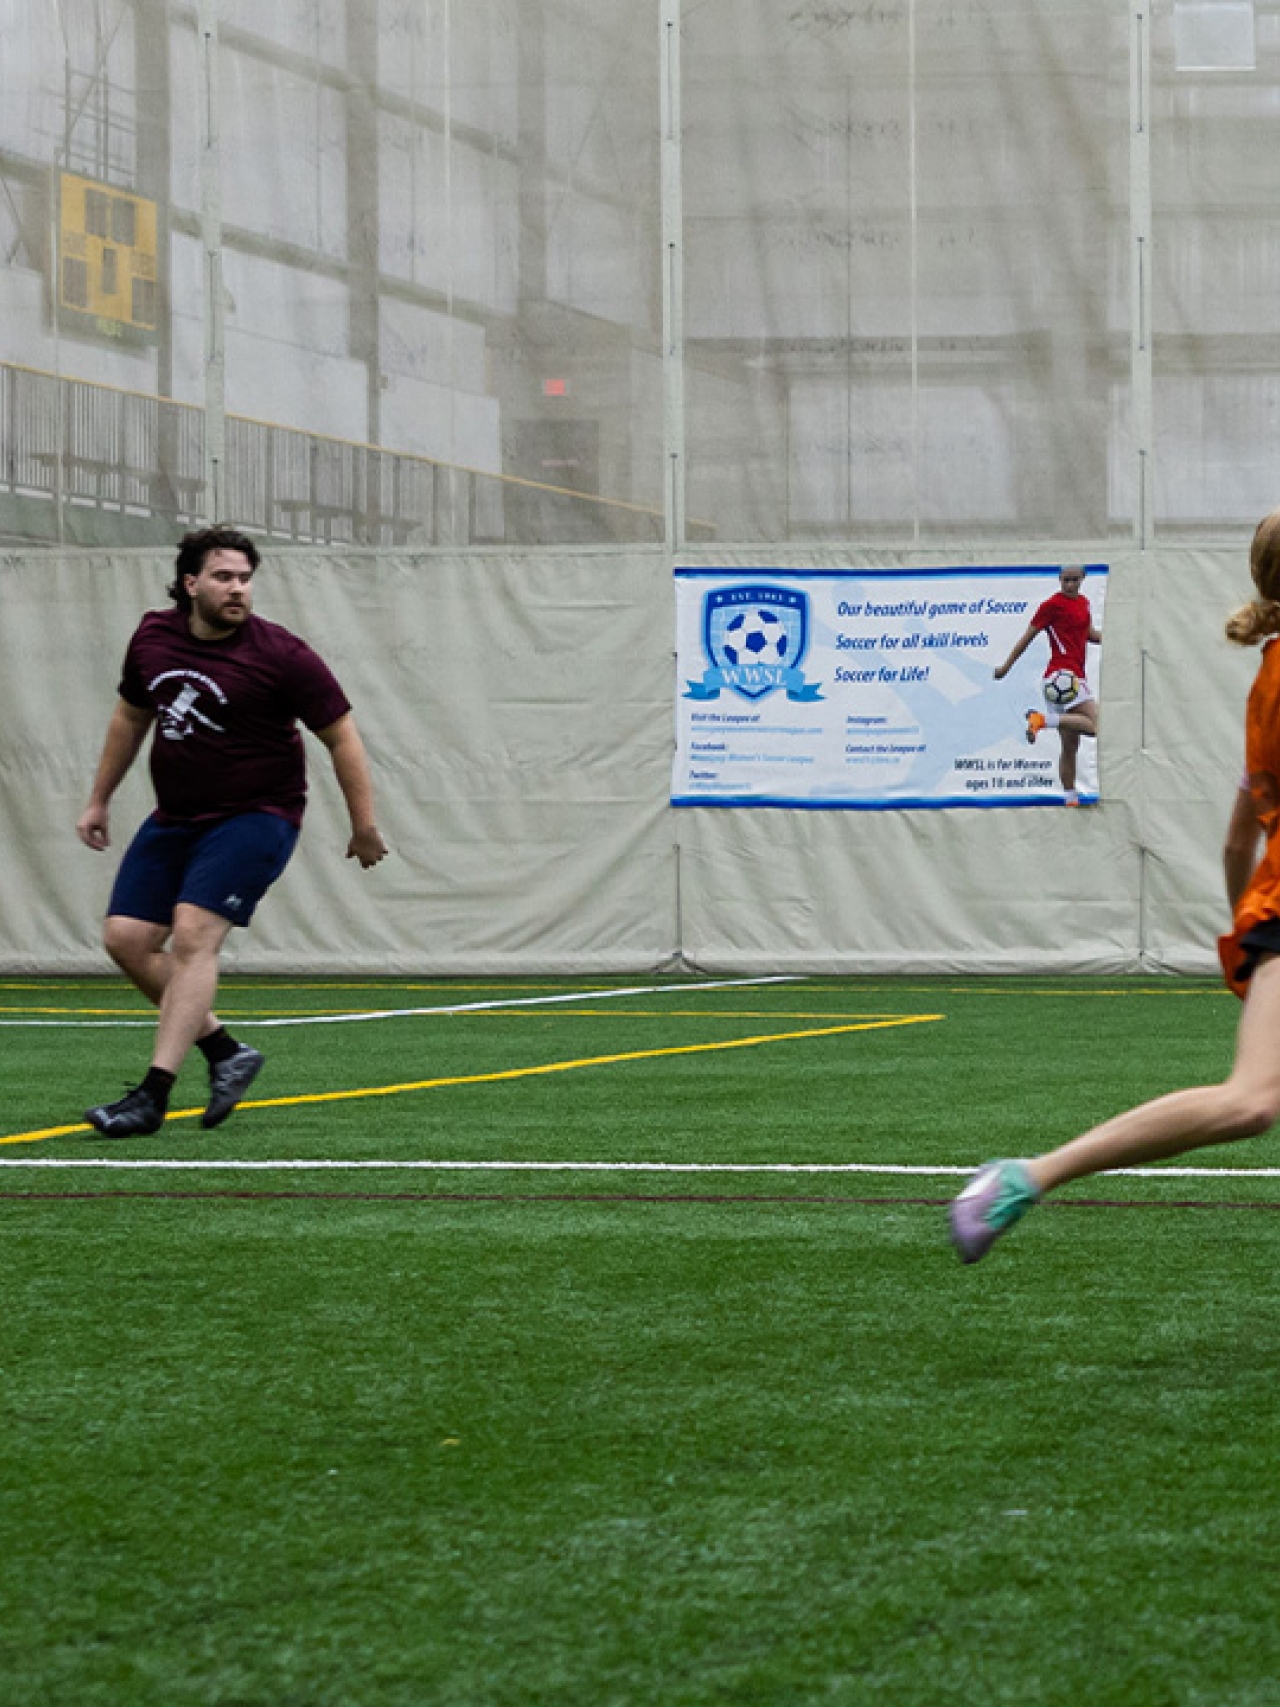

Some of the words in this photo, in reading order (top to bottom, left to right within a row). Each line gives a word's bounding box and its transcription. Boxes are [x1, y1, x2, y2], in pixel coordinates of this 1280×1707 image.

[838, 601, 863, 617] Our
[864, 601, 927, 617] beautiful
[928, 603, 967, 619] game
[968, 599, 985, 615] of
[985, 599, 1029, 615] Soccer
[835, 633, 878, 650] Soccer
[880, 633, 900, 649] for
[902, 633, 920, 649] all
[921, 632, 950, 648] skill
[951, 631, 989, 648] levels
[721, 667, 784, 685] WWSL
[834, 666, 877, 682] Soccer
[878, 666, 899, 682] for
[899, 665, 931, 682] Life!
[954, 759, 985, 771] WWSL
[997, 759, 1013, 771] for
[1013, 759, 1053, 770] Women
[965, 779, 989, 792] ages
[1006, 777, 1026, 789] and
[1027, 774, 1054, 788] older
